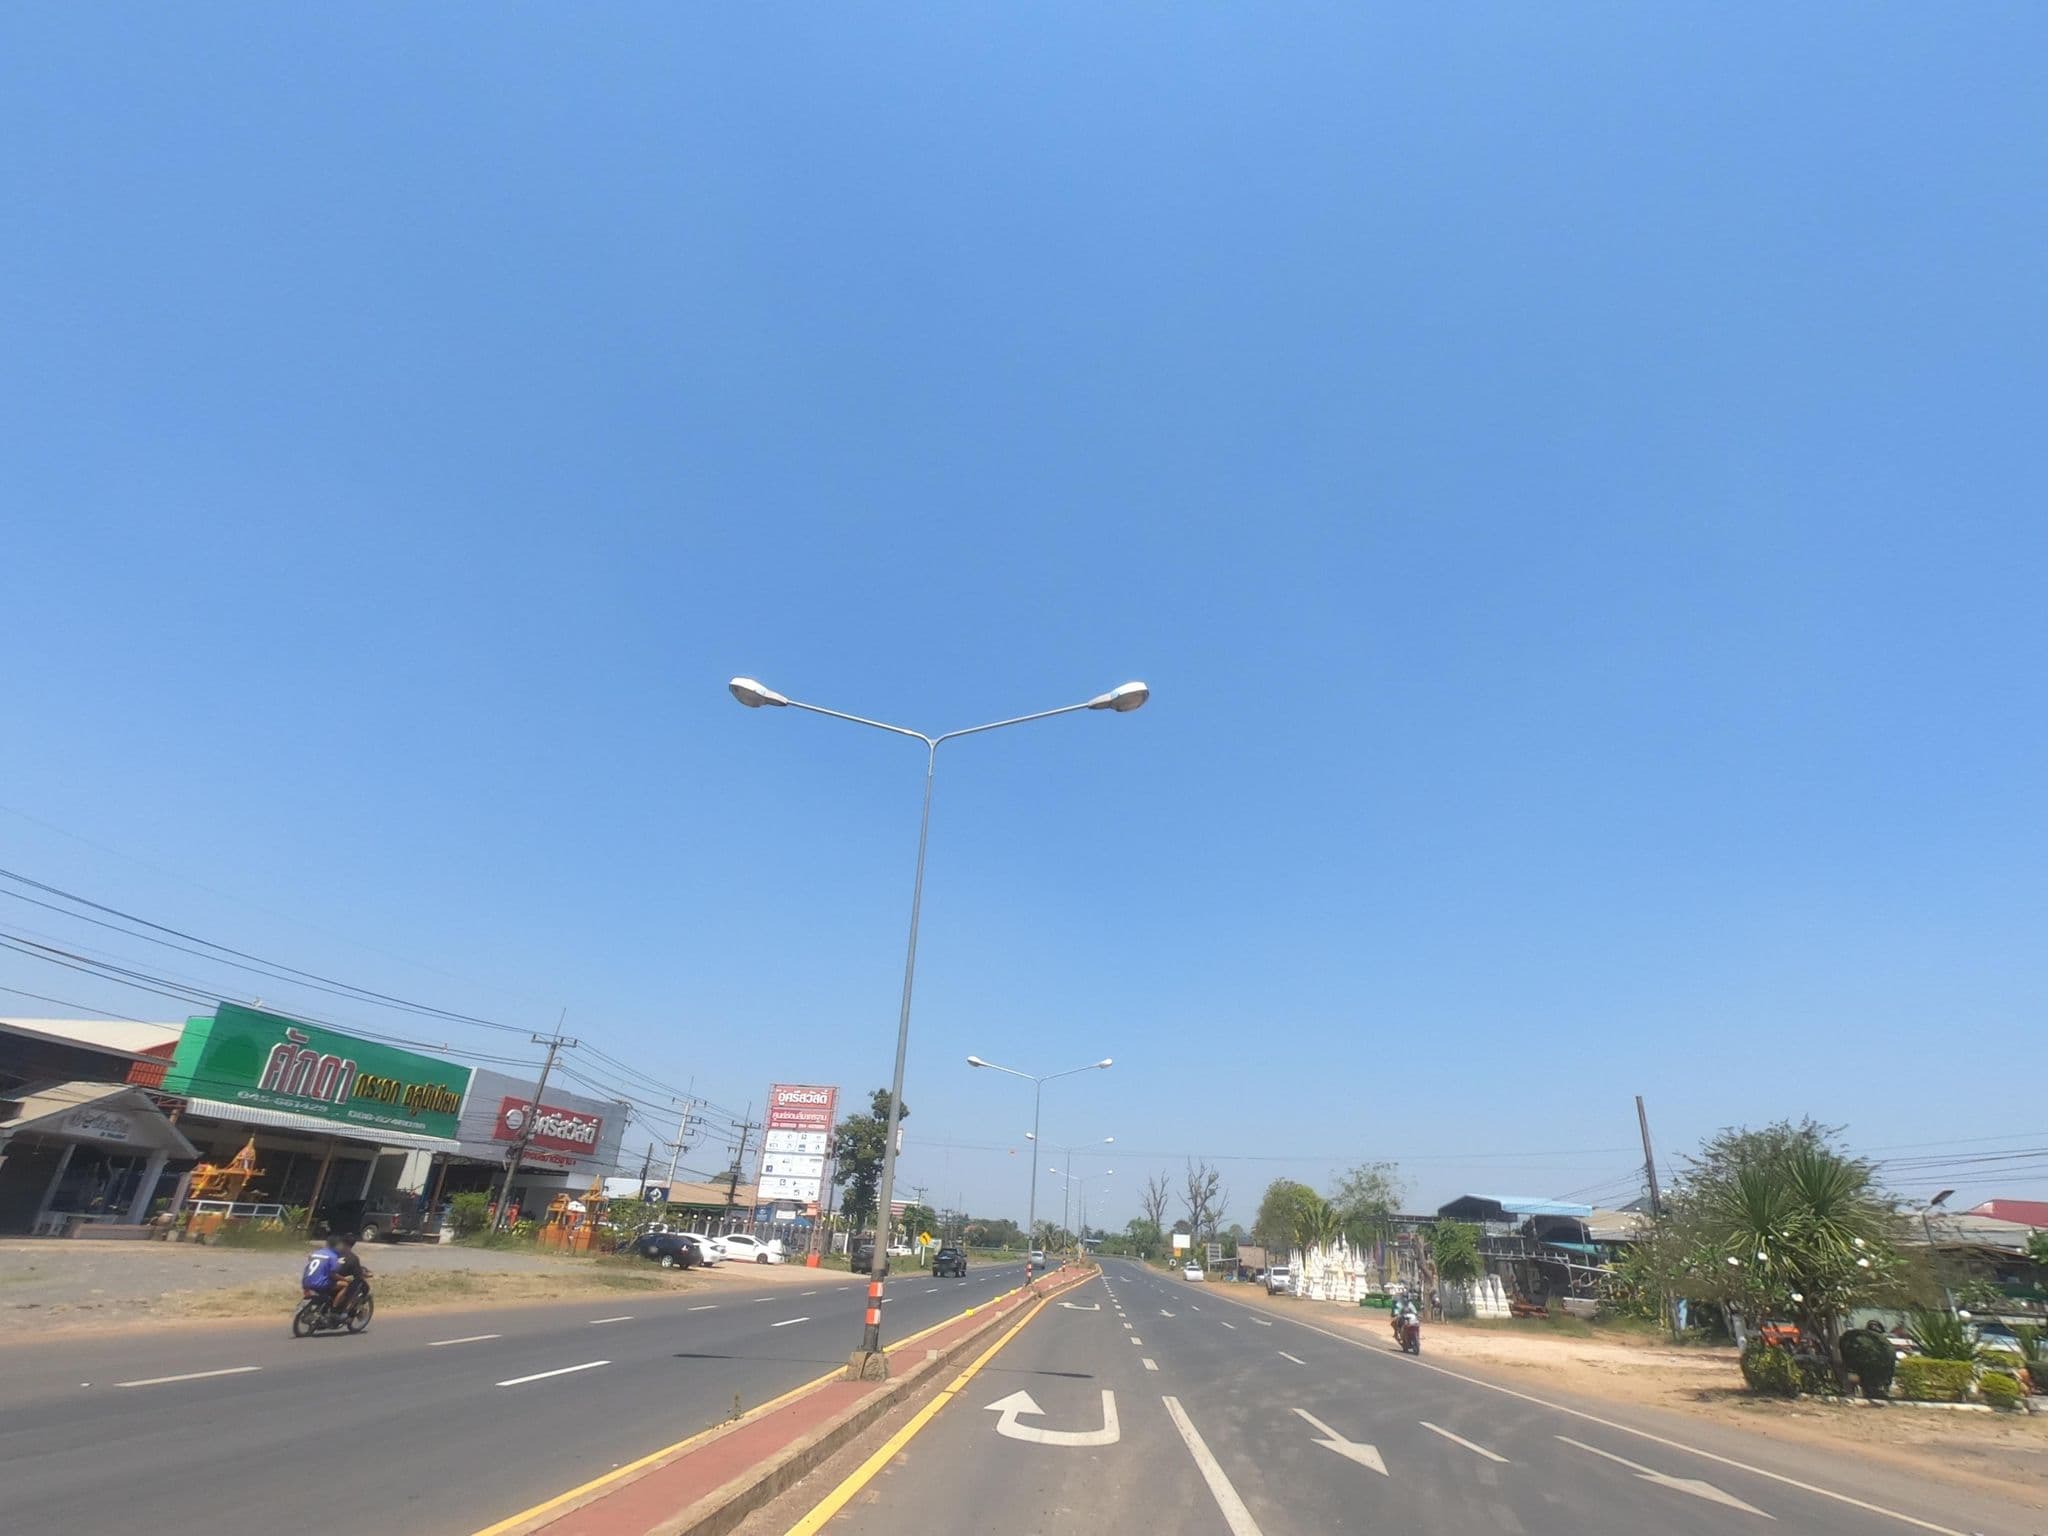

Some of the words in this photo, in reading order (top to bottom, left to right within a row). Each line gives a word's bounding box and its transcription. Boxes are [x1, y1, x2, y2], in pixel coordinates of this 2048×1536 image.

[257, 1027, 357, 1104] ศักดา
[352, 1073, 401, 1104] กระจก
[308, 1258, 321, 1276] 9
